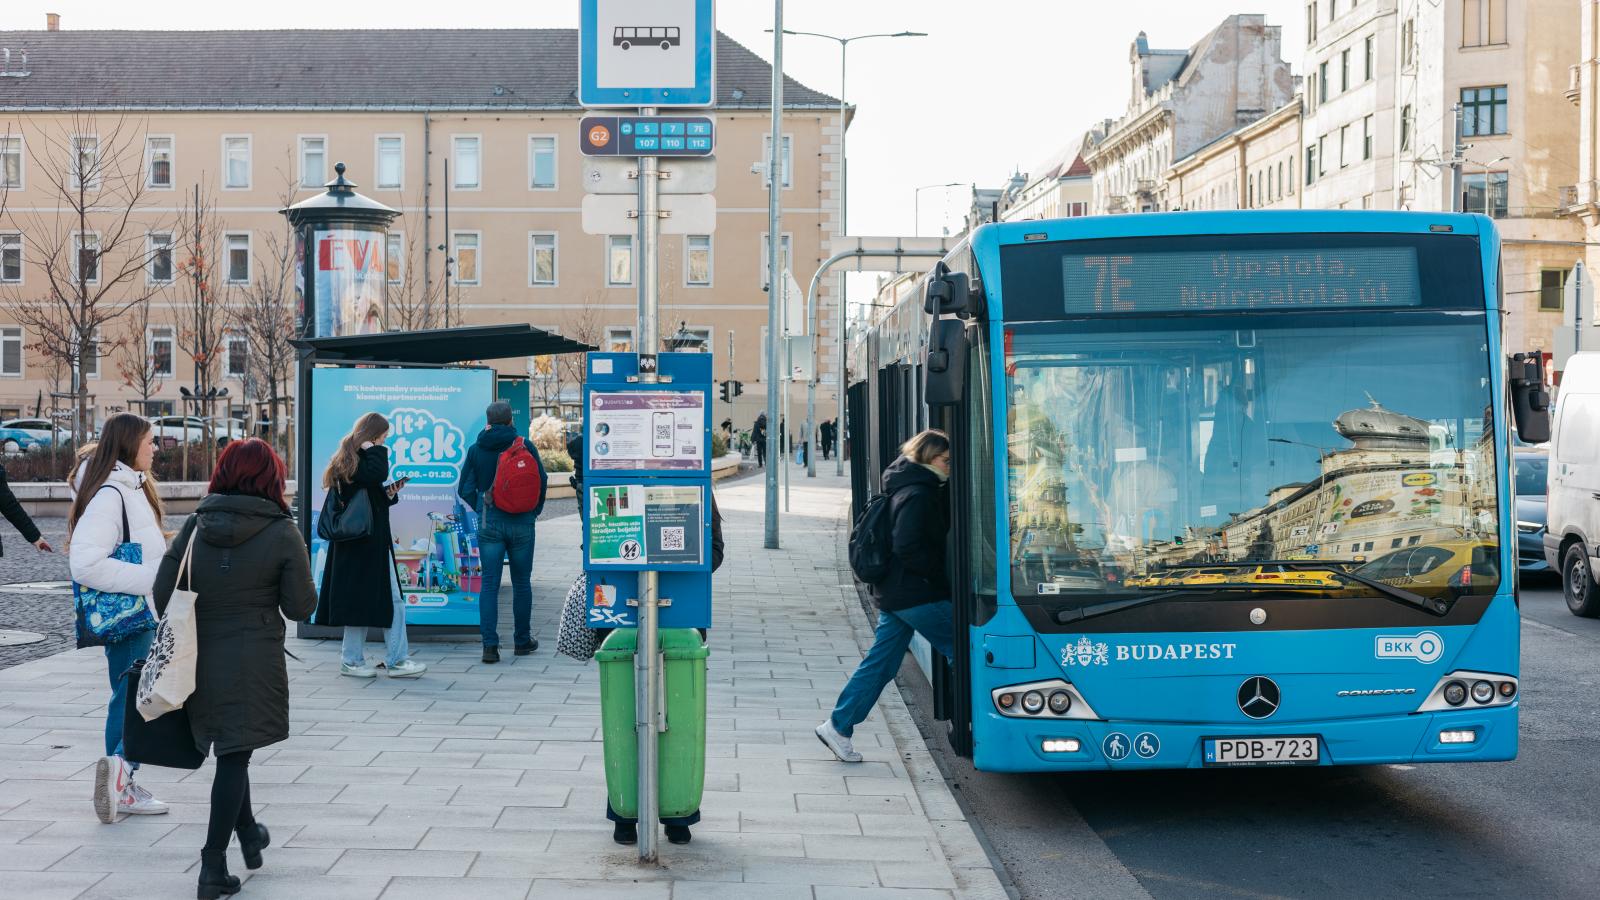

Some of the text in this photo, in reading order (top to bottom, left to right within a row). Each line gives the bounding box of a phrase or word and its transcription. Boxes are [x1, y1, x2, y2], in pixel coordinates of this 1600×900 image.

[591, 132, 608, 141] G2
[1212, 254, 1356, 281] Újpalota,
[1084, 256, 1136, 312] 7E
[1116, 643, 1236, 660] BUDAPEST
[1384, 642, 1413, 653] BKK
[1336, 688, 1417, 697] CONECTO
[1219, 739, 1313, 760] PDB-723
